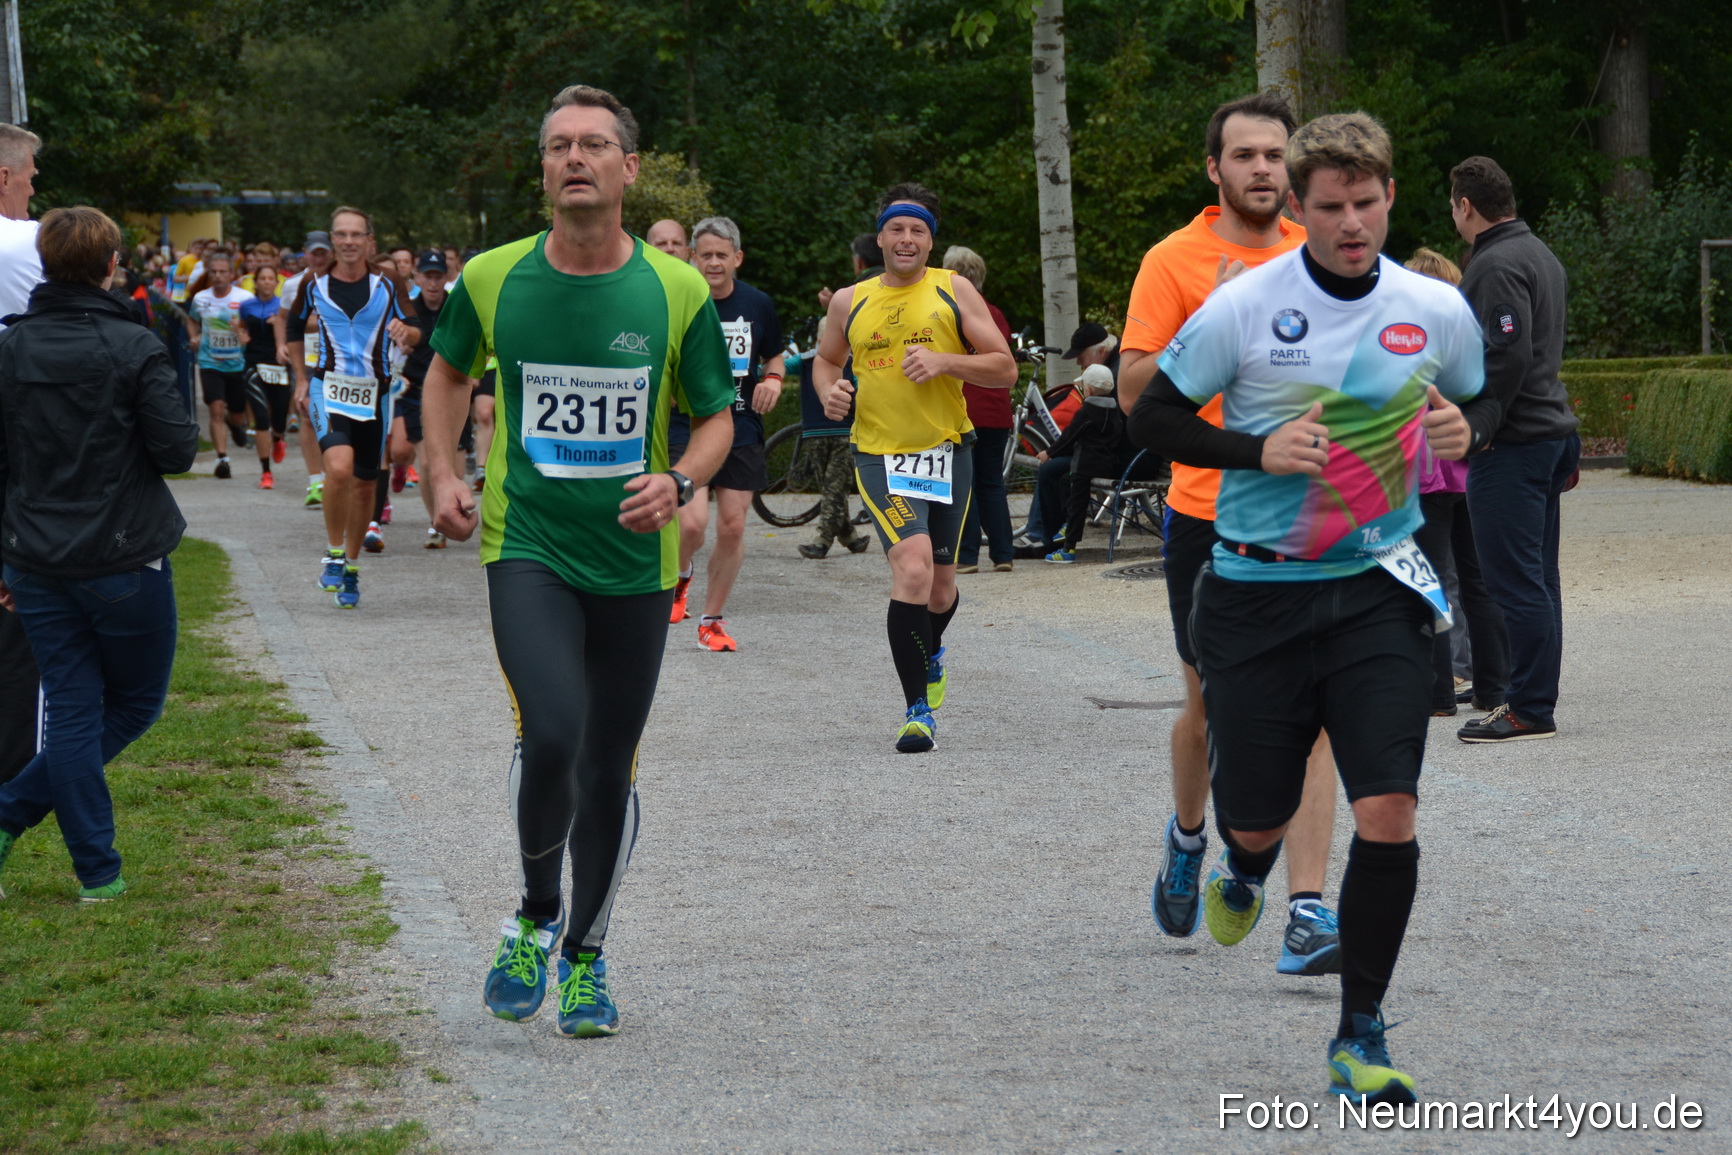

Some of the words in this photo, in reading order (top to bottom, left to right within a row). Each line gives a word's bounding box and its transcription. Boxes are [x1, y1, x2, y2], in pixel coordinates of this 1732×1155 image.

[611, 331, 651, 351] AOK
[1270, 349, 1310, 358] PARTL
[526, 374, 566, 387] PARTL
[570, 377, 628, 389] Neumarkt
[329, 384, 371, 405] 3058
[536, 392, 637, 435] 2315
[554, 444, 617, 462] Thomas
[892, 453, 946, 478] 2711
[908, 480, 933, 492] Alfred
[891, 496, 913, 518] Run!
[1361, 526, 1383, 545] 16.
[1396, 549, 1437, 587] 25
